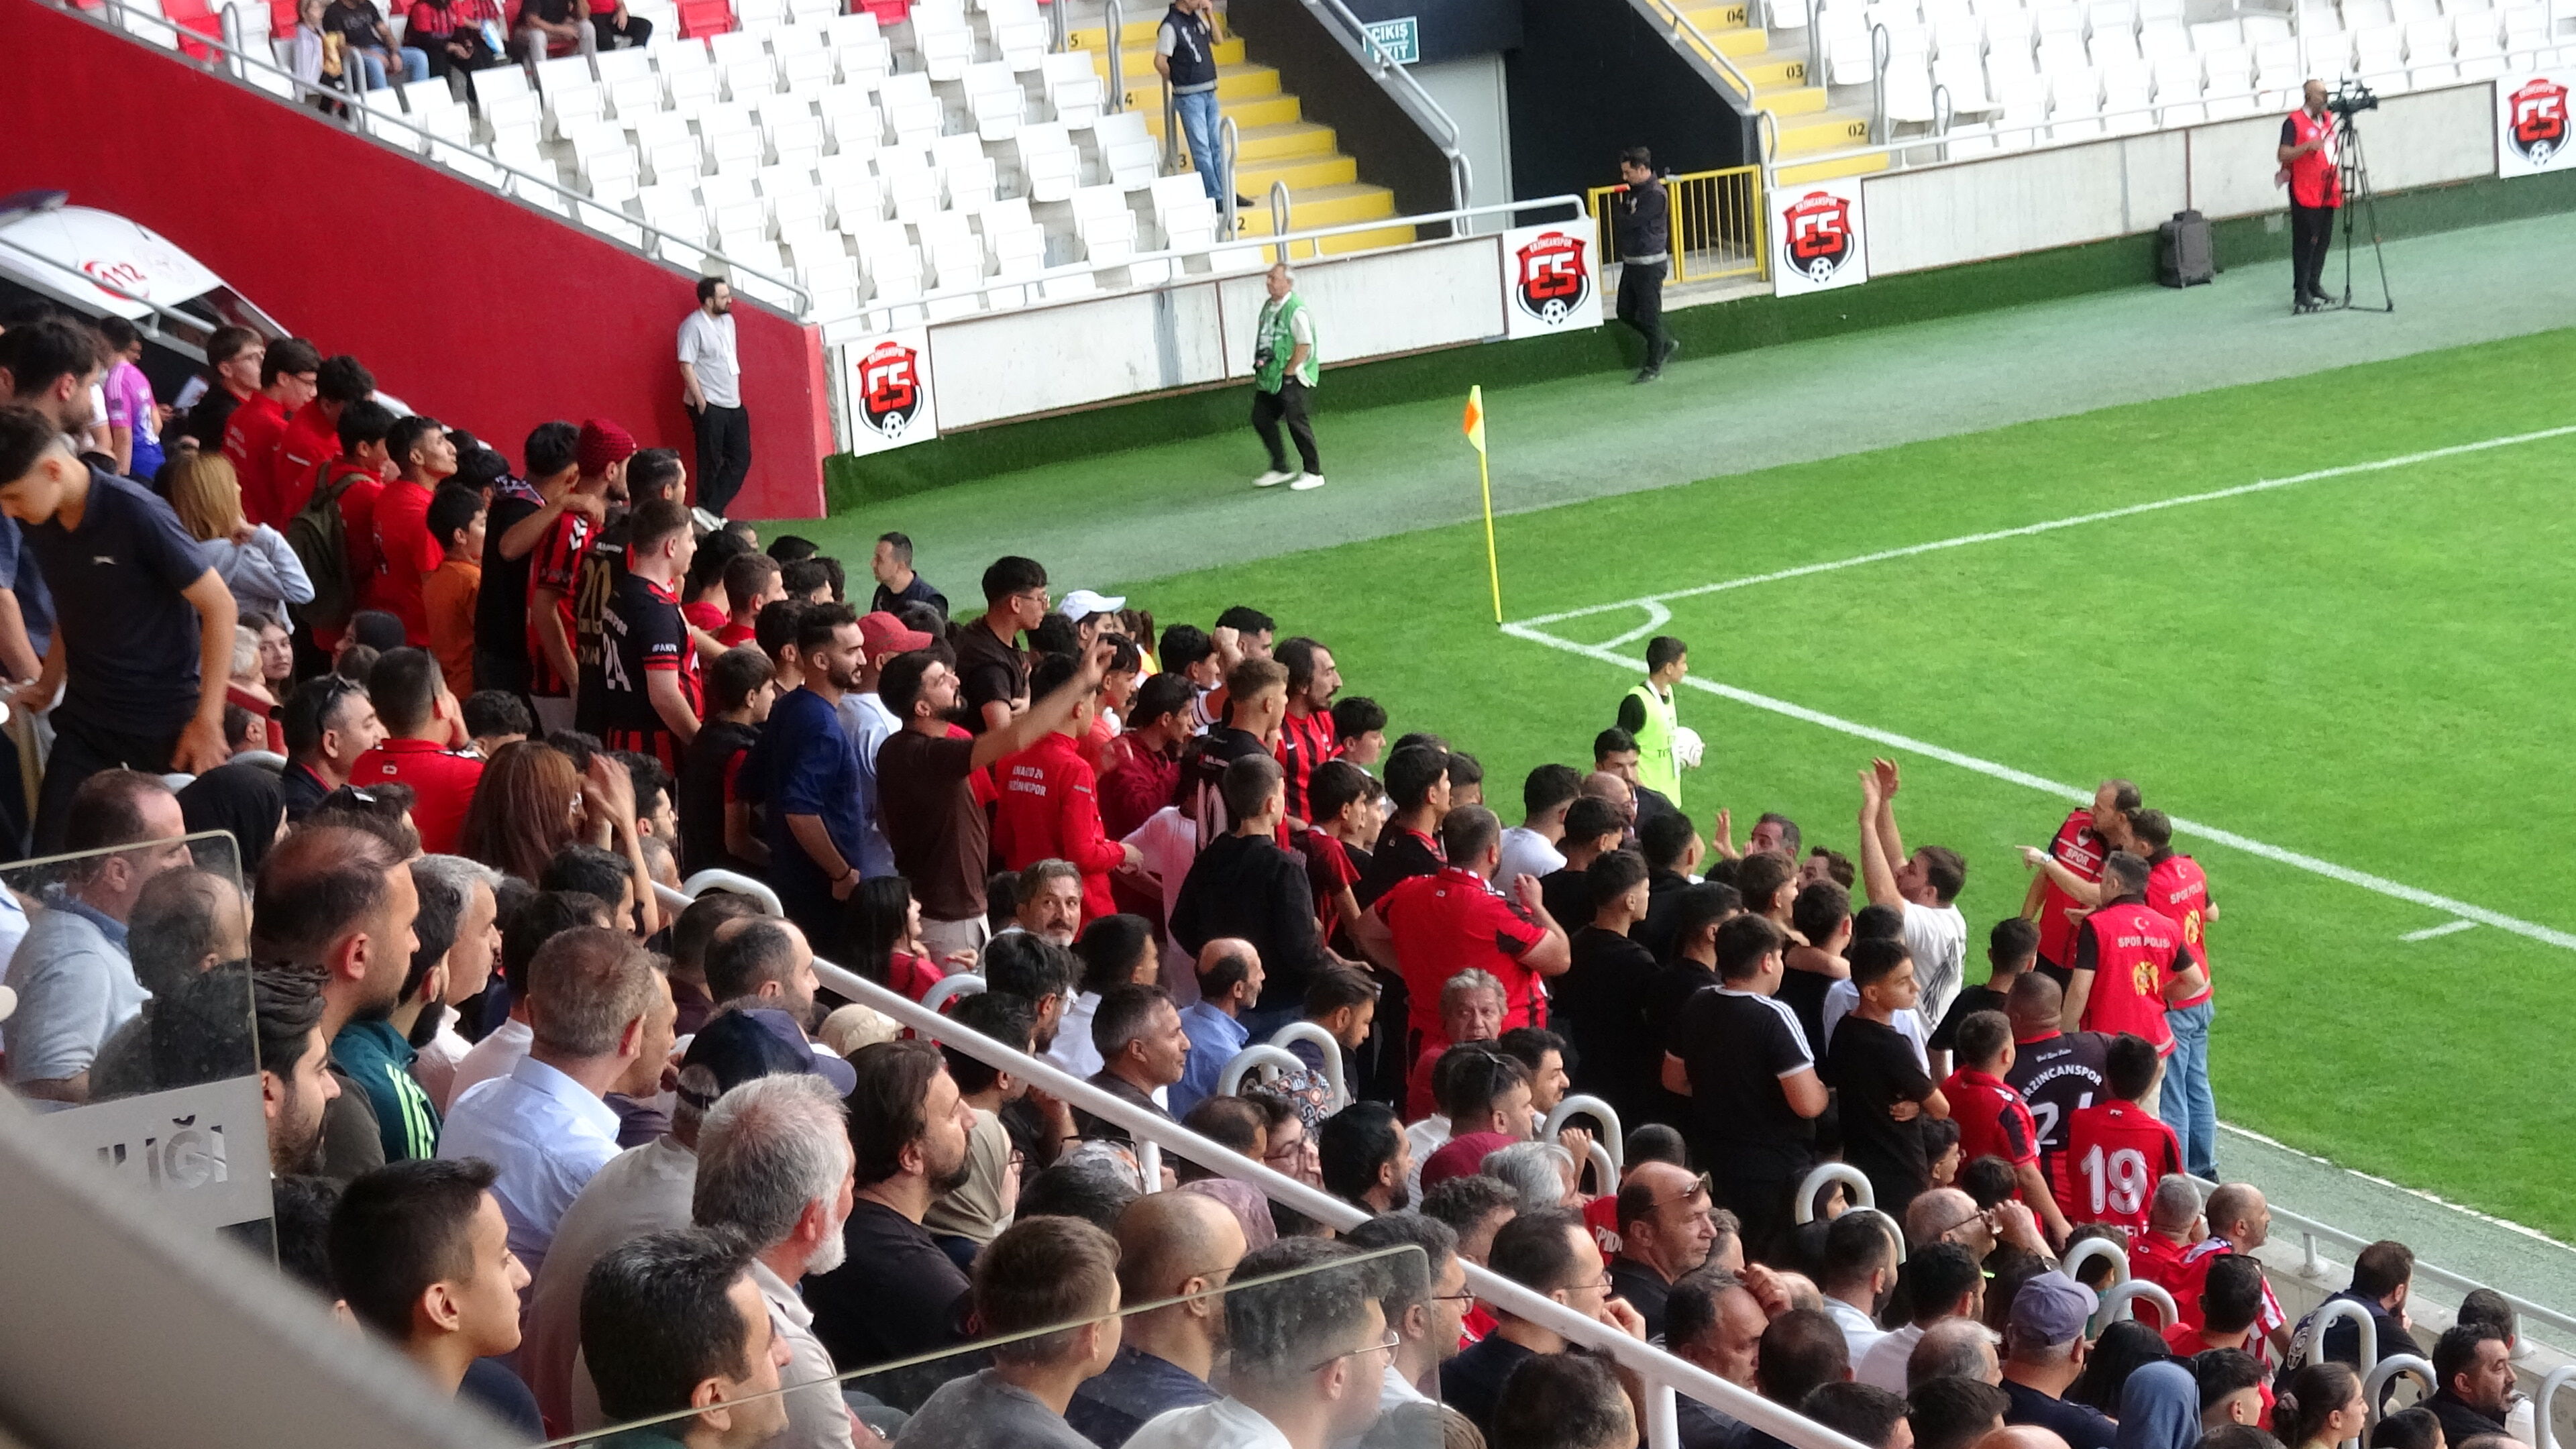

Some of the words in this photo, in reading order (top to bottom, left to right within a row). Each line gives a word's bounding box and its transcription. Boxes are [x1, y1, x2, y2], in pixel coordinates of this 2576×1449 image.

[1727, 9, 1744, 23] 04
[1786, 64, 1803, 79] 03
[1848, 122, 1866, 137] 02
[101, 262, 147, 288] 112
[2065, 847, 2090, 867] SPOR
[2117, 936, 2141, 949] SPOR
[2019, 1064, 2103, 1103] ERZINCANSPOR
[2080, 1143, 2148, 1215] 19
